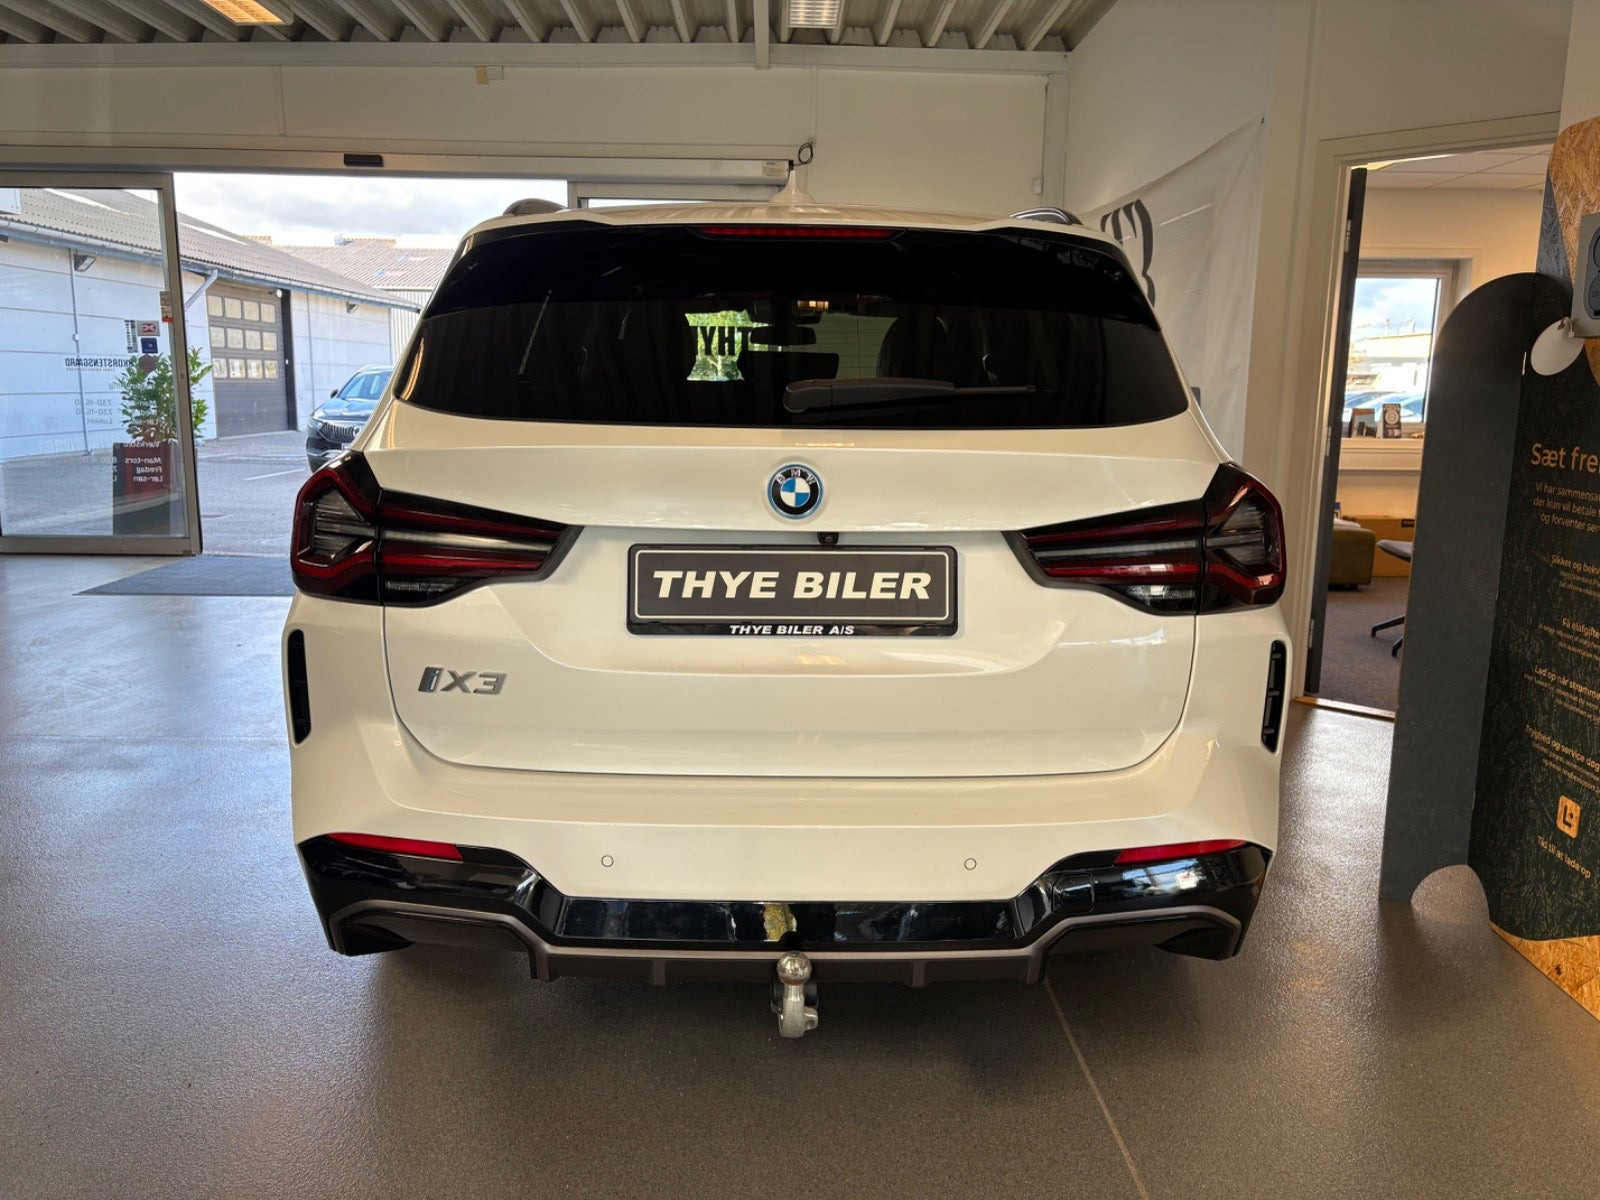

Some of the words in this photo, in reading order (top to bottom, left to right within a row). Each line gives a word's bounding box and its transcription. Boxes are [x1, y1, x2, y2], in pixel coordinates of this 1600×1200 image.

[1530, 442, 1567, 469] Sæt
[1571, 446, 1600, 474] fre
[776, 468, 817, 485] BMW
[1535, 481, 1544, 492] Vi
[1544, 483, 1557, 495] har
[1533, 496, 1546, 507] der
[1546, 498, 1561, 509] kun
[1562, 501, 1572, 512] vil
[1572, 503, 1597, 517] betale
[1540, 513, 1551, 525] og
[1551, 513, 1586, 530] forventer
[1572, 562, 1582, 573] og
[653, 570, 780, 599] THYE
[793, 572, 932, 600] BILER
[730, 624, 773, 635] THYE
[776, 624, 823, 635] BILER
[418, 666, 507, 695] iX3
[1547, 671, 1557, 682] op
[1551, 739, 1561, 752] og
[1561, 744, 1585, 763] service
[1537, 834, 1548, 849] Tid
[1548, 843, 1556, 855] til
[1580, 866, 1591, 879] op
